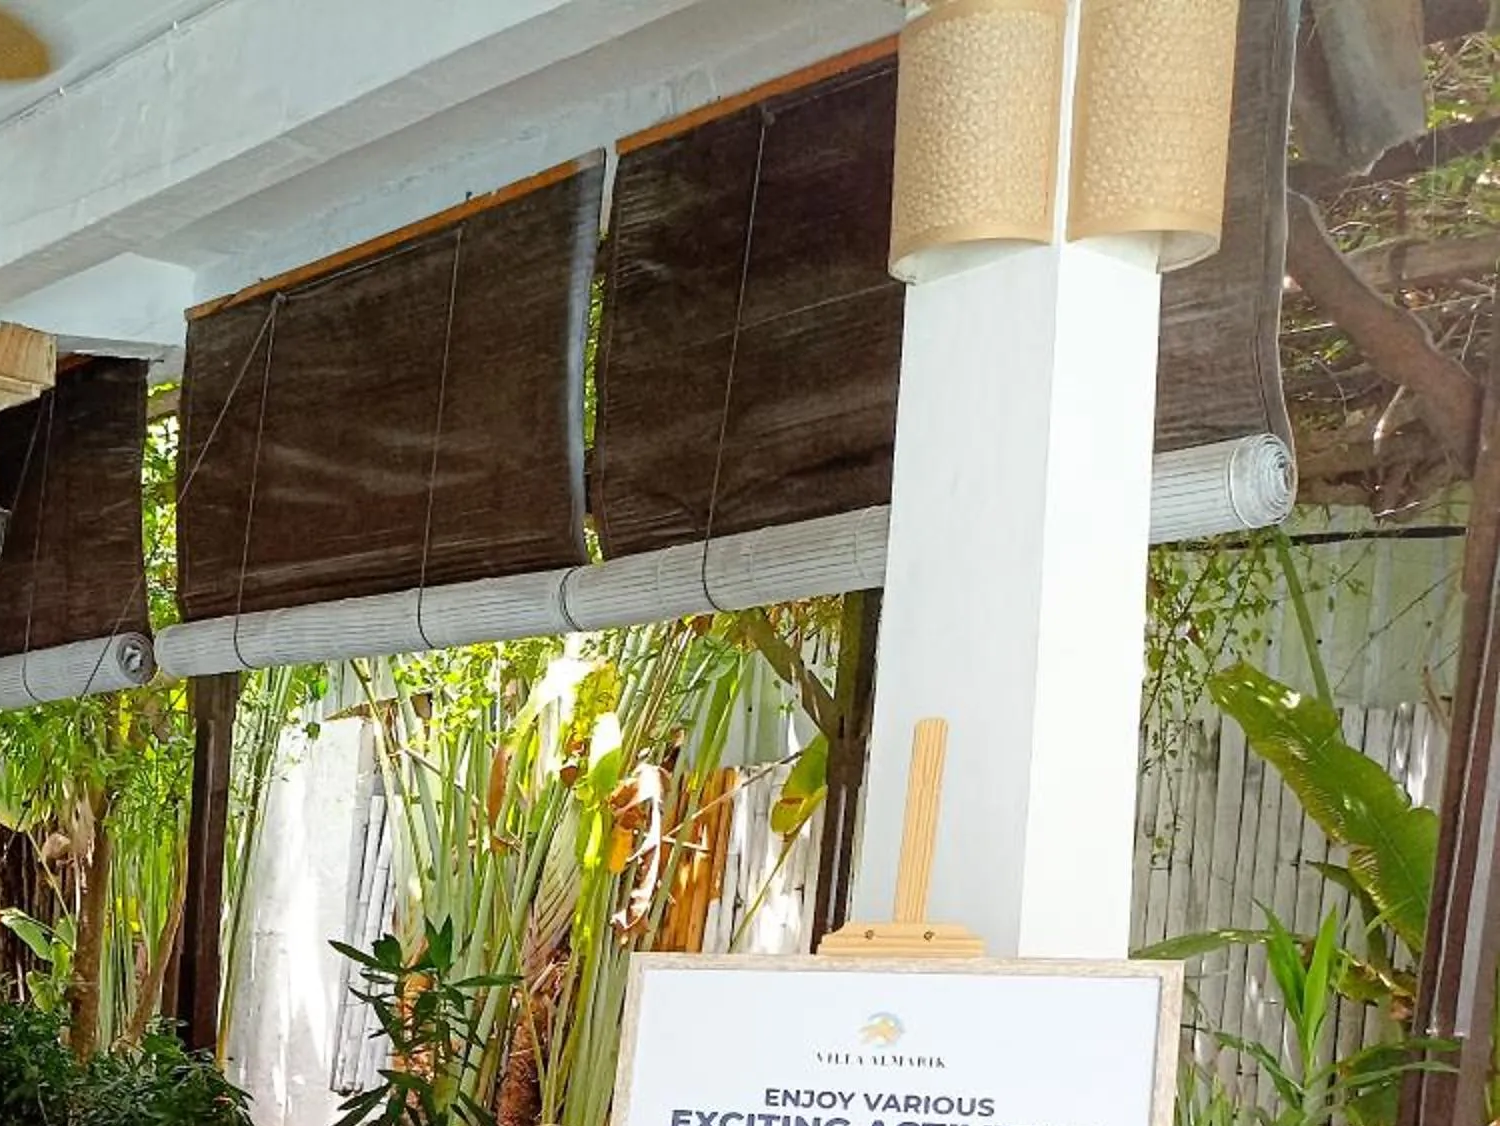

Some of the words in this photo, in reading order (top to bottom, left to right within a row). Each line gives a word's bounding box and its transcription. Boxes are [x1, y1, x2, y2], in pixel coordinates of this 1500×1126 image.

[816, 1051, 864, 1066] VILLA
[765, 1088, 856, 1110] ENJOY
[863, 1093, 995, 1117] VARIOUS
